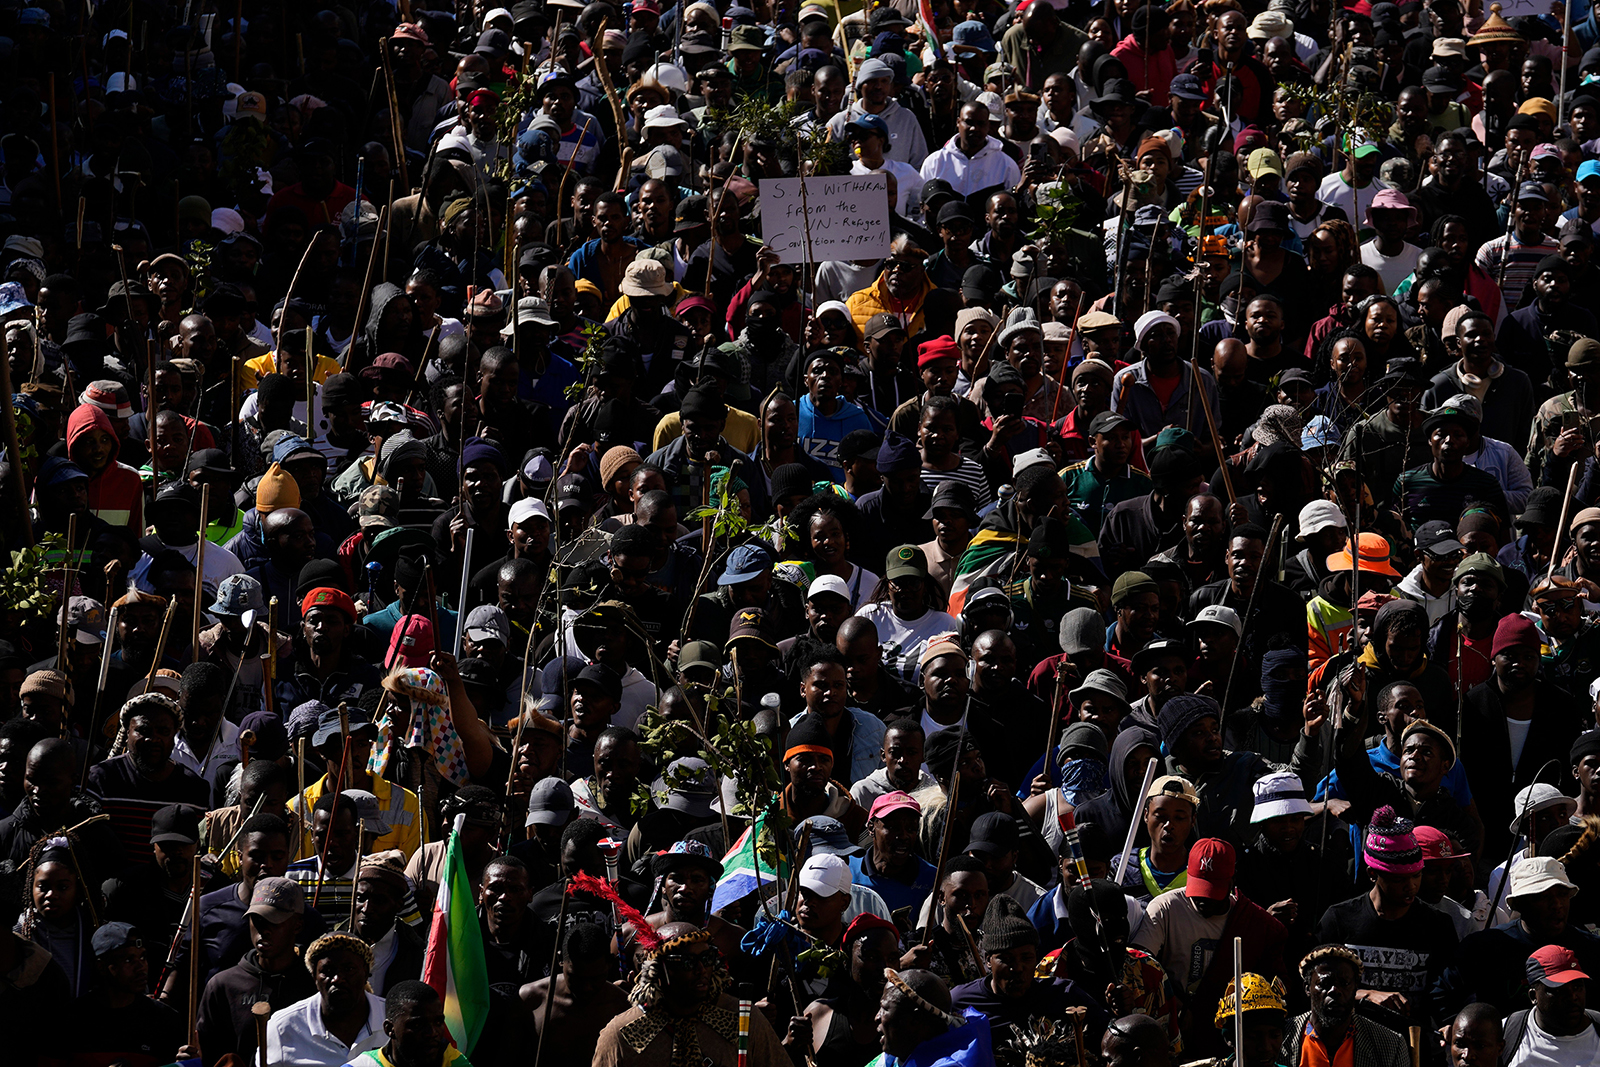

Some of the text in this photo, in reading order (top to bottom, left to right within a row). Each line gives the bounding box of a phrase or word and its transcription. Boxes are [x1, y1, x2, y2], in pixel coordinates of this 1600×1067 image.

[835, 200, 857, 213] the
[841, 236, 854, 244] of
[1192, 945, 1203, 977] INSPIRED
